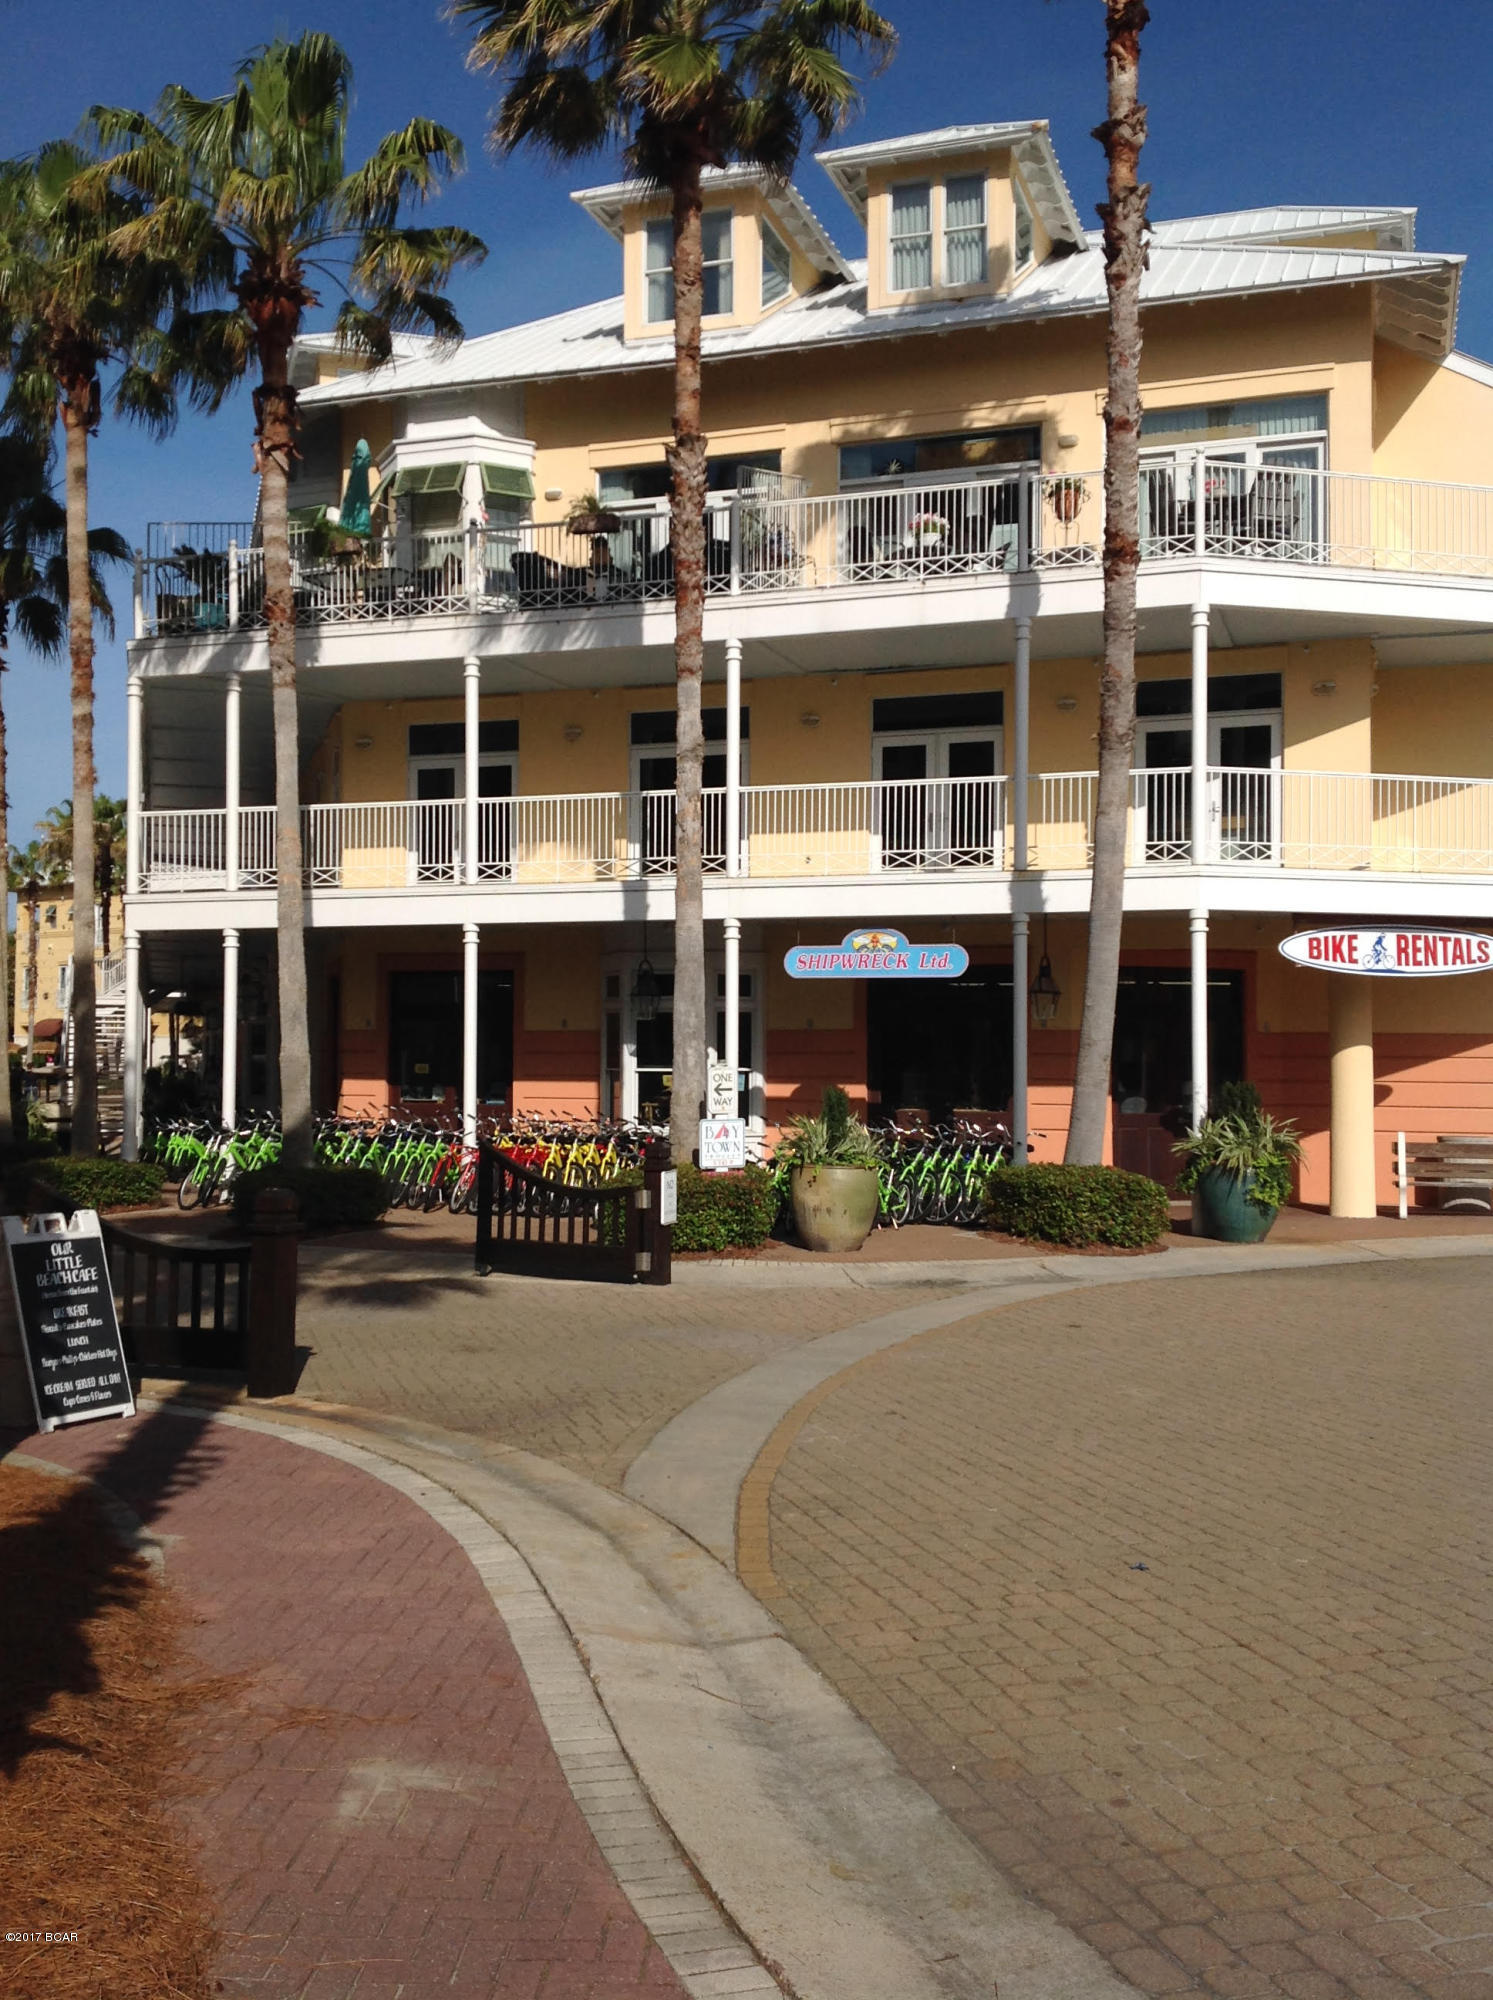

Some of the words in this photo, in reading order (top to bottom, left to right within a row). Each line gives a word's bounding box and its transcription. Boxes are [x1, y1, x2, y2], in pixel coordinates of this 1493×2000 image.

[1308, 935, 1359, 964] BIKE
[1396, 934, 1490, 966] RENTALS
[796, 953, 910, 970] SHIPWRECK
[712, 1073, 733, 1082] ONE
[713, 1097, 733, 1106] WAY
[705, 1123, 739, 1140] BAY
[704, 1141, 740, 1153] TOWN
[50, 1241, 74, 1256] OUR
[45, 1255, 83, 1272] LITTLE
[36, 1270, 72, 1288] BEACH
[72, 1267, 99, 1283] CAFE
[66, 1335, 89, 1347] LUNCH
